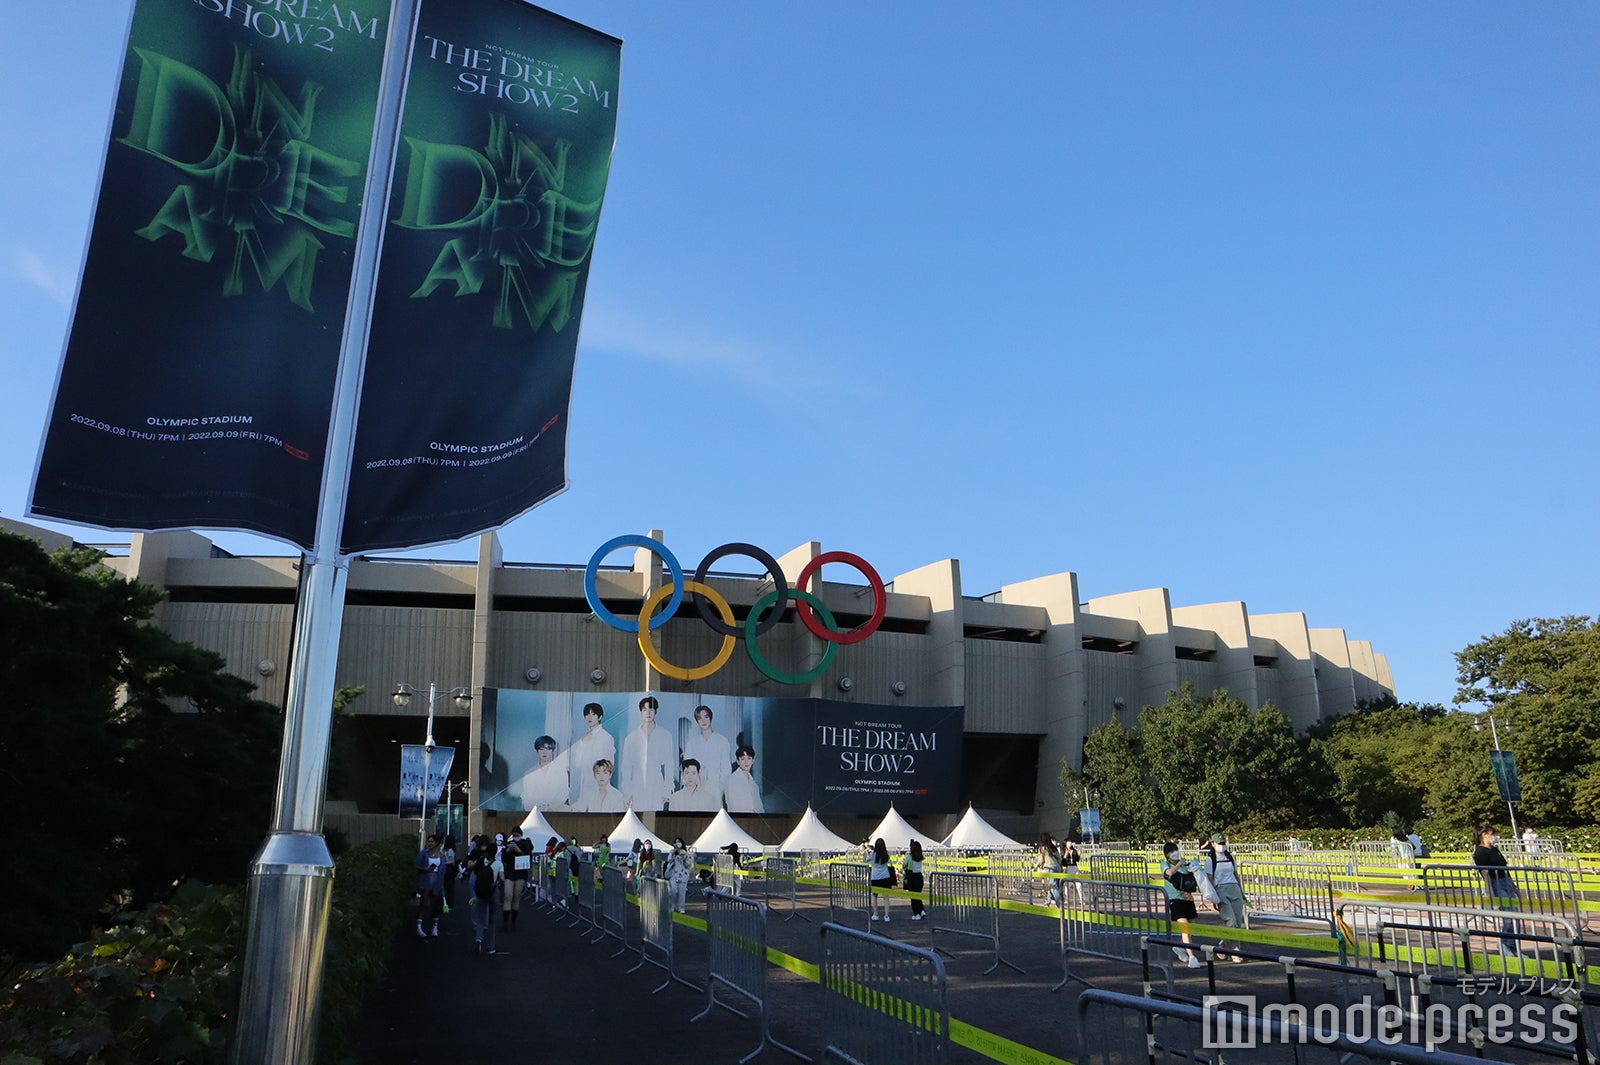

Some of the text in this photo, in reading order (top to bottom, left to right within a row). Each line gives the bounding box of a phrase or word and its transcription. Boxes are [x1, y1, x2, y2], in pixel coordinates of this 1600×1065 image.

[254, 0, 379, 39] REAM
[485, 44, 559, 70] NCT DREAM TOUR
[425, 36, 609, 108] THE DREAM
[146, 415, 253, 427] OLYMPIC STADIUM
[158, 433, 179, 442] 7PM
[264, 434, 283, 447] 7PM
[430, 441, 478, 454] OLYMPIC
[480, 436, 524, 453] STADIUM
[440, 458, 460, 467] 7PM
[817, 725, 936, 751] THE DREAM
